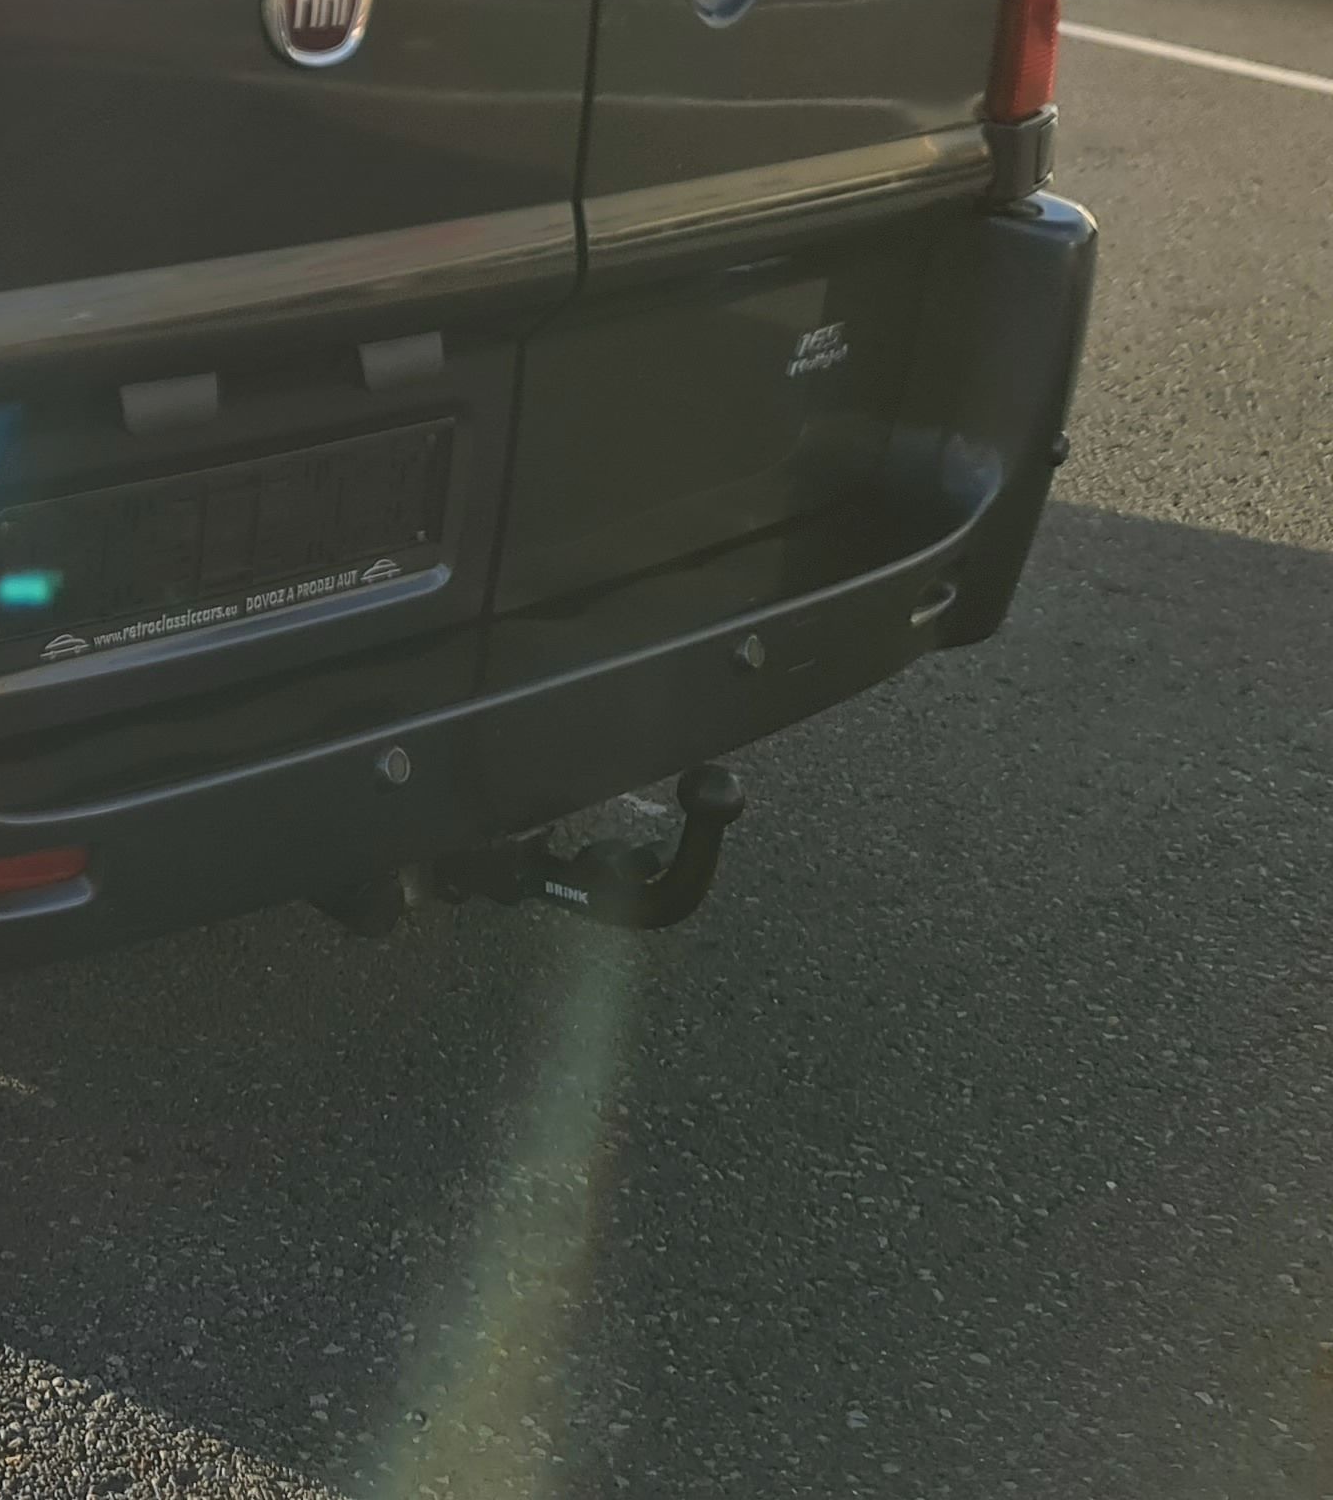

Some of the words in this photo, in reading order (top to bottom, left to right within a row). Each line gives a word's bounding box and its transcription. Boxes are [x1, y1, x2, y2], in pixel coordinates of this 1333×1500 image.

[93, 603, 238, 647] www.retroclassiccars.eu
[245, 590, 286, 613] DOVOZ
[286, 587, 295, 603] A
[297, 575, 336, 598] PRODEJ
[335, 569, 359, 590] AUT
